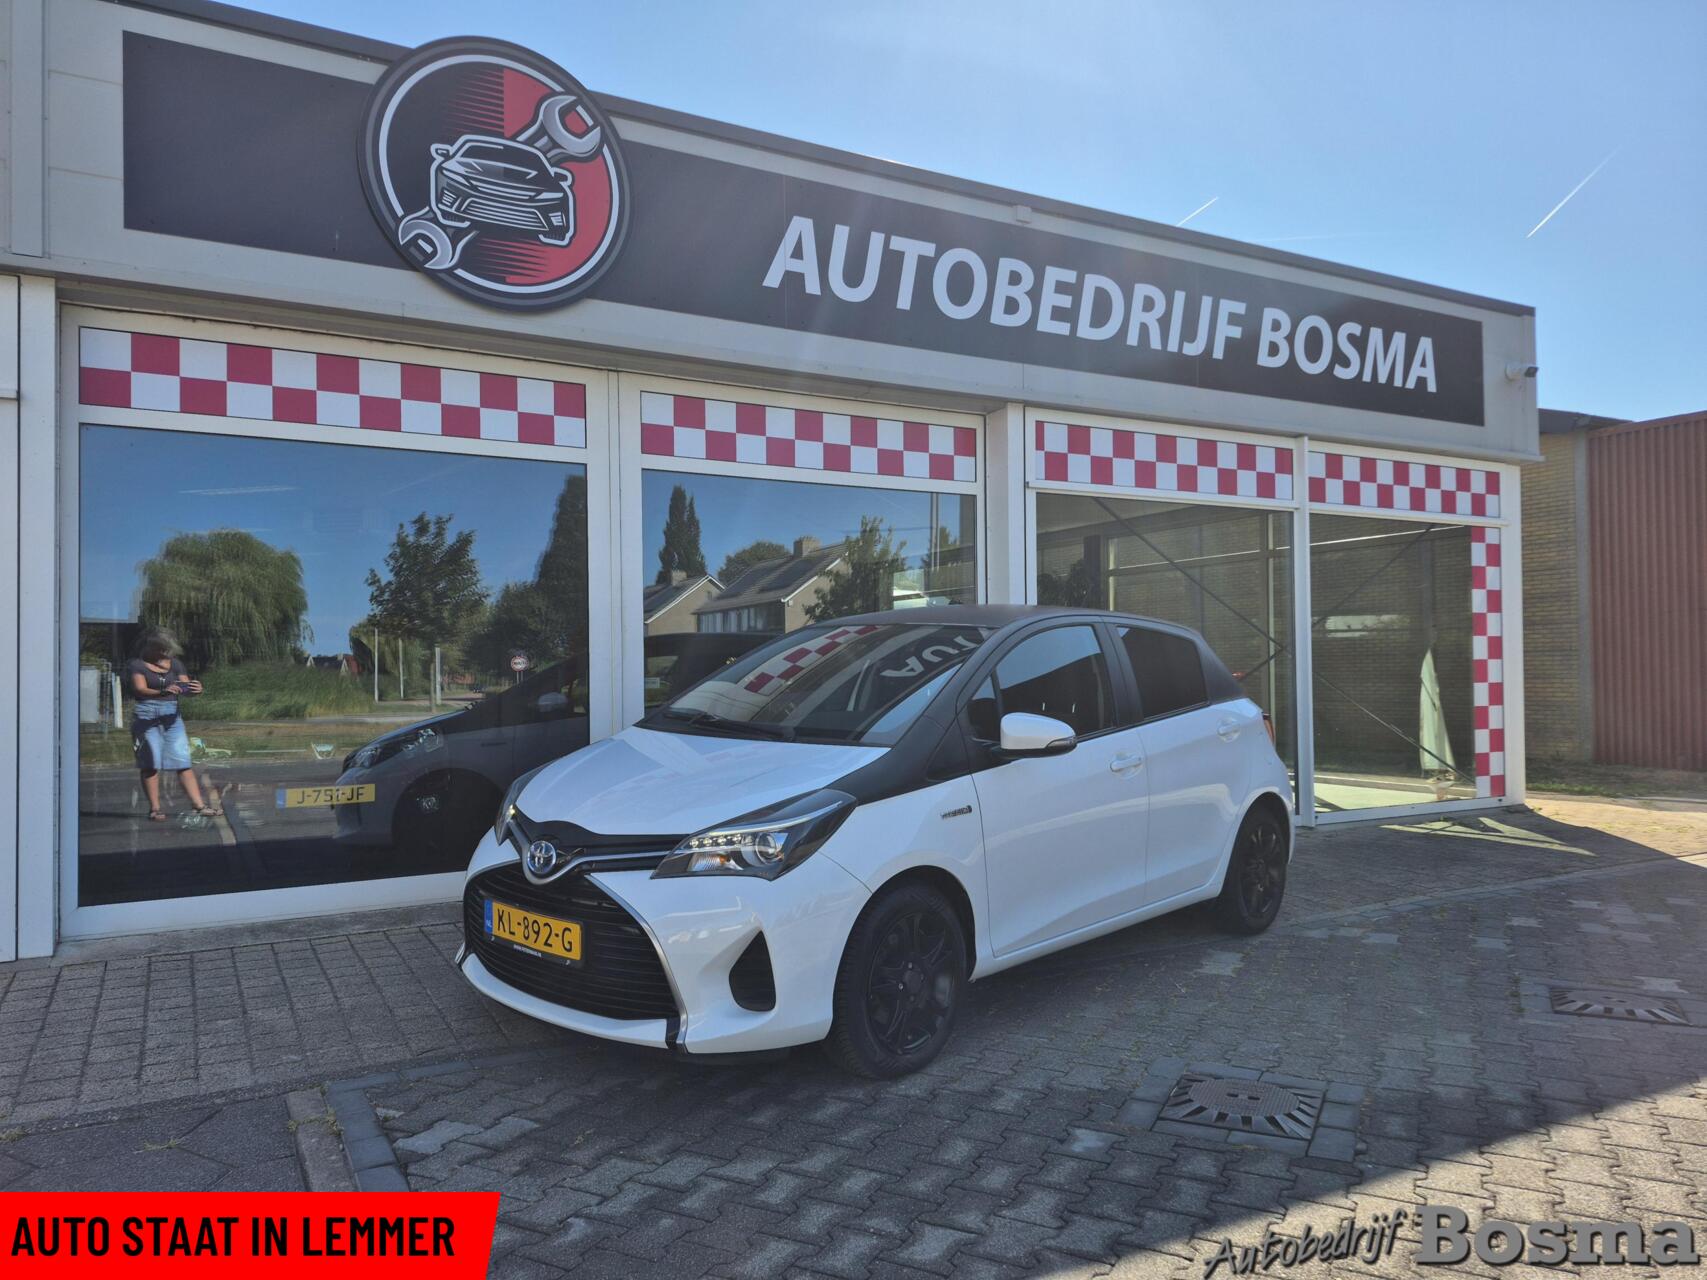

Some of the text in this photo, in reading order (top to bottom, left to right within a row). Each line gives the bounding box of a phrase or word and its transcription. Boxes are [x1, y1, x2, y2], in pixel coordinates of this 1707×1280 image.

[762, 215, 1438, 393] AUTOBEDRIJF BOSMA
[497, 908, 573, 953] KL-892-G
